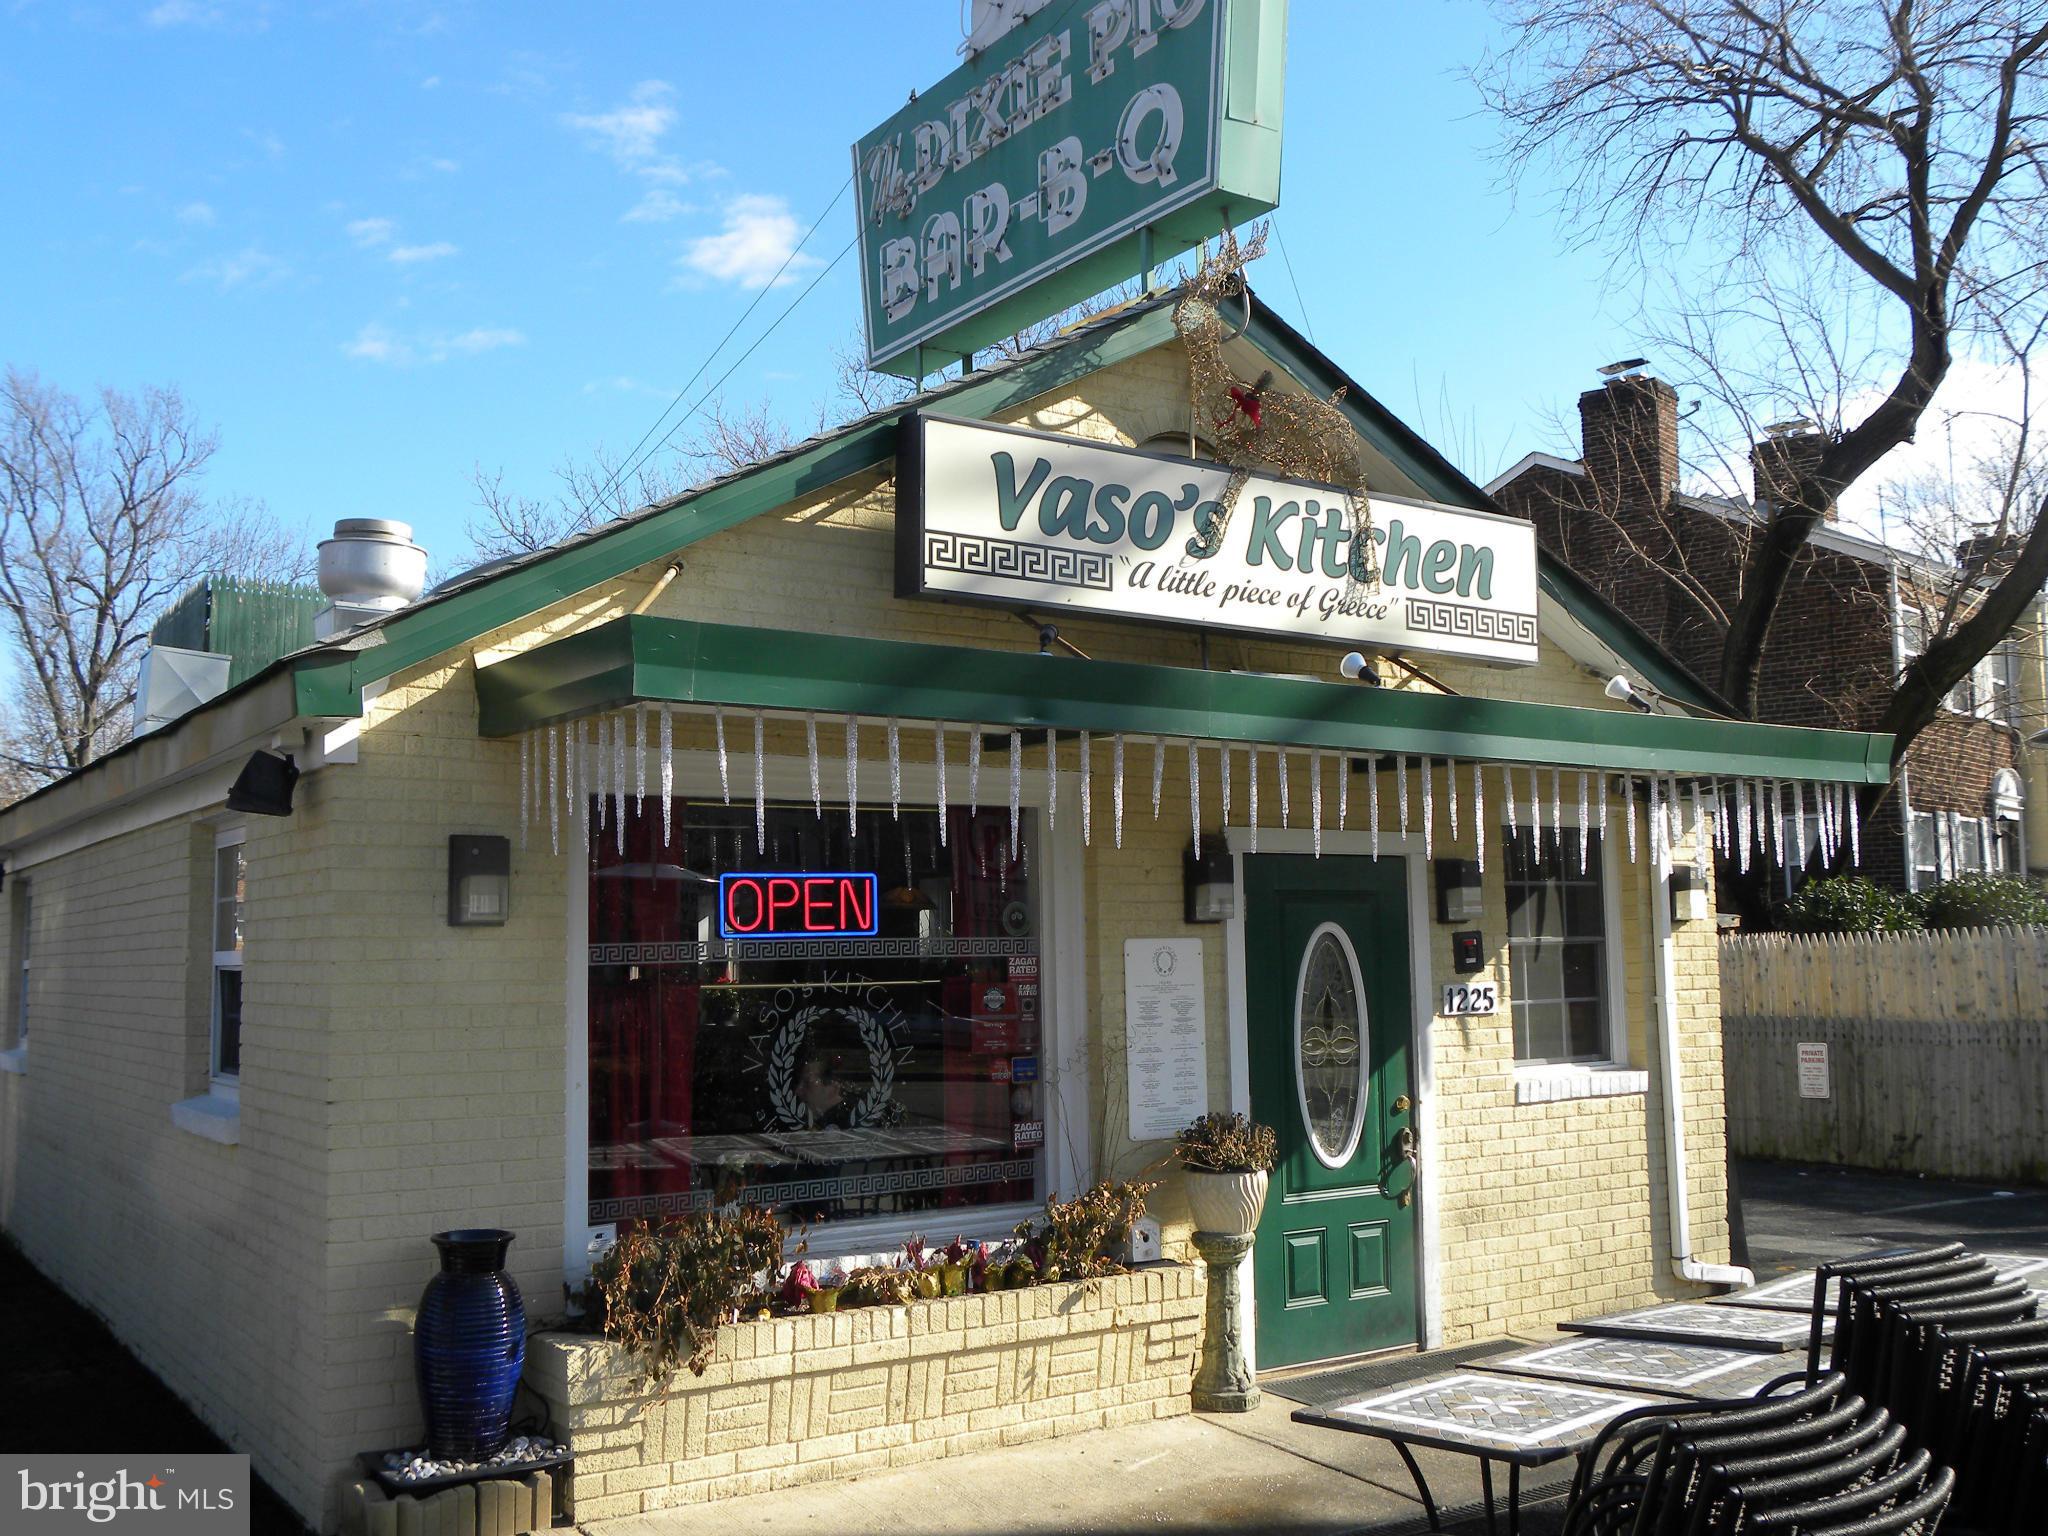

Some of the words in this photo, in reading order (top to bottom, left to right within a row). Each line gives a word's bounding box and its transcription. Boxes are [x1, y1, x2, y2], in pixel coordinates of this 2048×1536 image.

[911, 29, 1072, 195] DIXIE
[880, 83, 1184, 325] BAR-B-Q
[991, 451, 1225, 559] Vaso's
[1246, 495, 1494, 600] Kitchen
[1157, 564, 1216, 597] little
[1219, 579, 1281, 608] piece
[1286, 585, 1316, 618] of
[727, 877, 872, 932] OPEN
[1008, 957, 1037, 966] ZAGAT
[1008, 965, 1037, 974] RATED
[824, 969, 916, 1066] KITCHEN
[1447, 987, 1494, 1013] 1225
[1014, 1121, 1043, 1132] ZAGAT
[1014, 1130, 1043, 1141] RATED
